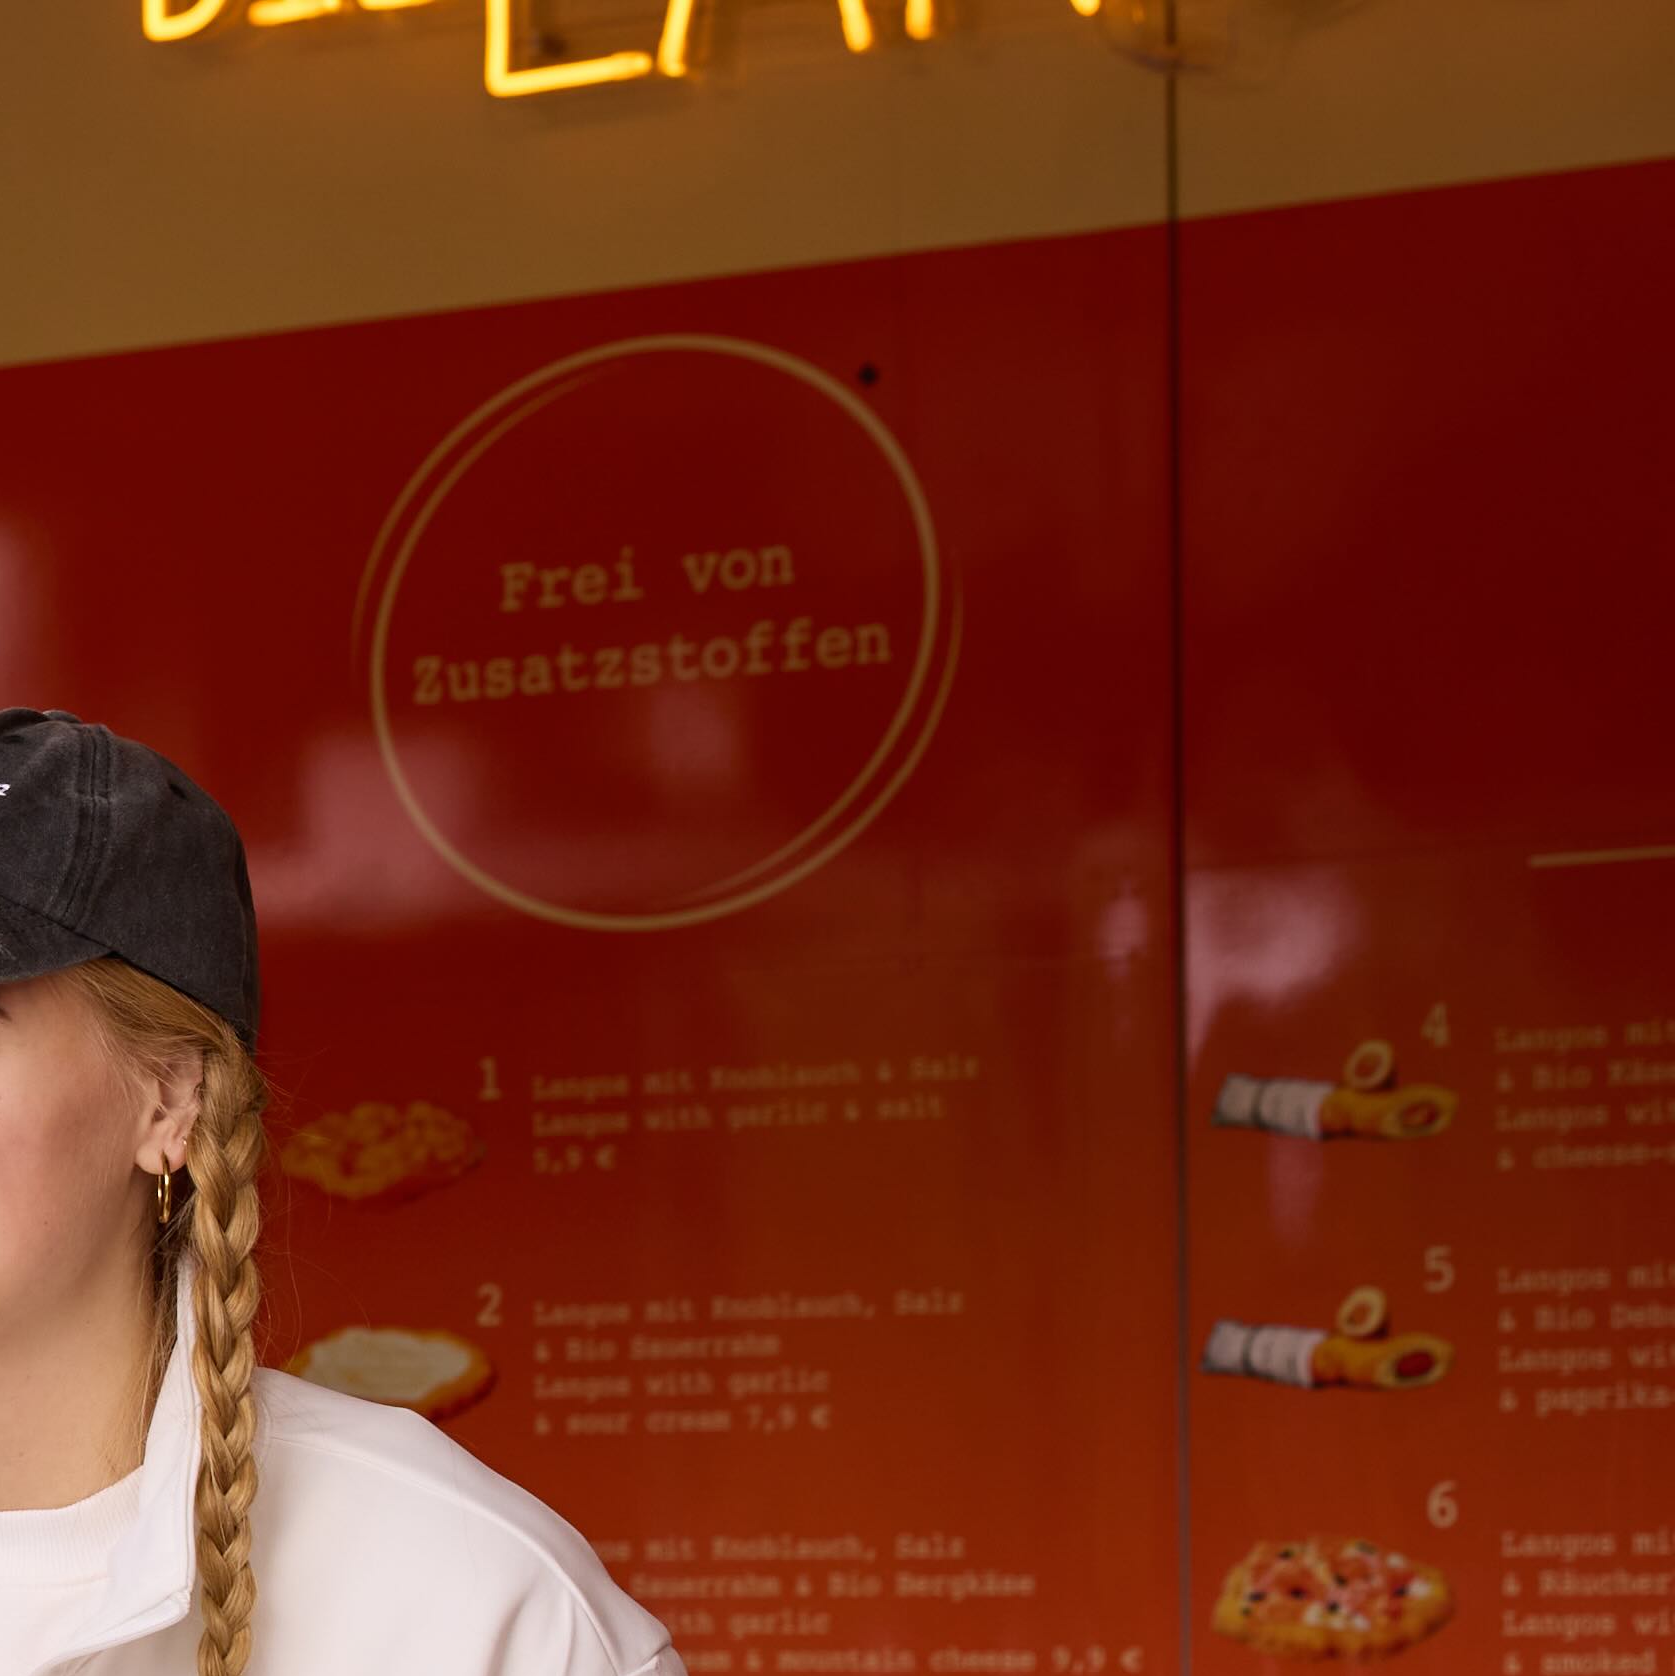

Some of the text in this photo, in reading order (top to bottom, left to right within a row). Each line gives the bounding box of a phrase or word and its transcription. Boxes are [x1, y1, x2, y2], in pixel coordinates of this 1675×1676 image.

[497, 542, 797, 614] Frei von
[411, 615, 894, 706] Zusatzstoffen
[1420, 1000, 1452, 1050] 4
[479, 1056, 502, 1101] 1
[1422, 1242, 1457, 1295] 5
[475, 1282, 505, 1328] 2
[1425, 1477, 1460, 1530] 6
